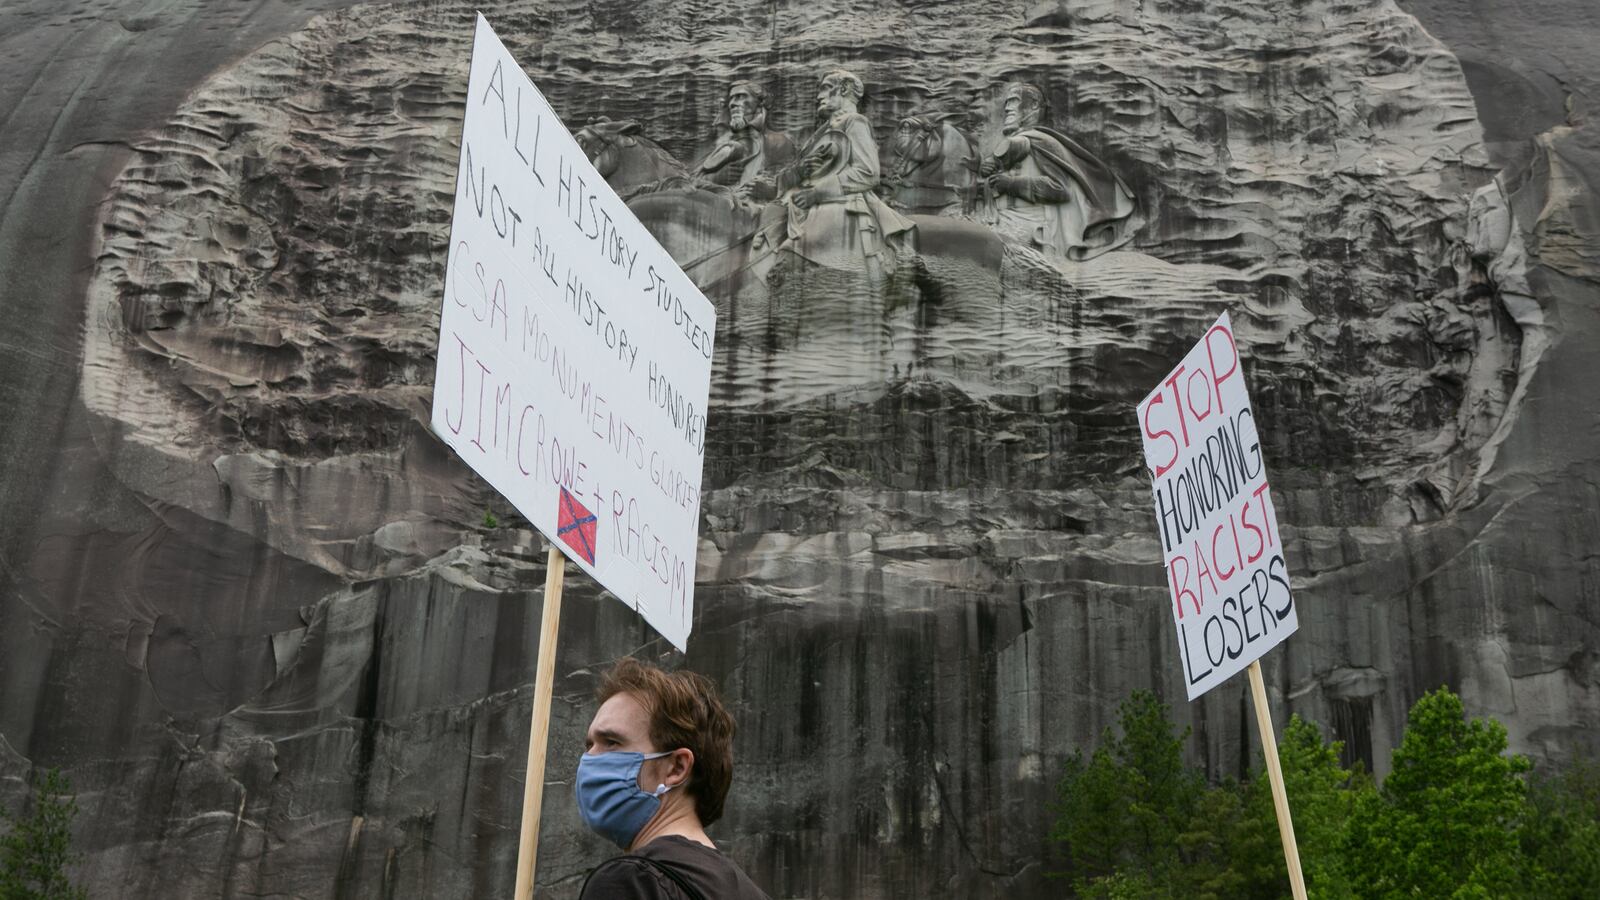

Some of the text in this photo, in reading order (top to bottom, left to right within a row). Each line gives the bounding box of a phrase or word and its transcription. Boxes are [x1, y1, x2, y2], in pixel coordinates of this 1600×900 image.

[465, 141, 706, 456] NOT ALL HISTORY HONORED
[482, 59, 712, 359] ALL HISTORY STUDIED
[446, 331, 512, 462] JIM
[517, 404, 588, 497] CROWE
[612, 489, 686, 630] RACISM
[452, 240, 701, 531] CSA MONUMENTS GLORIFY
[1144, 324, 1238, 479] STOP
[1156, 407, 1262, 553] HONORING
[1169, 481, 1273, 619] RACIST
[1180, 554, 1293, 686] LOSERS
